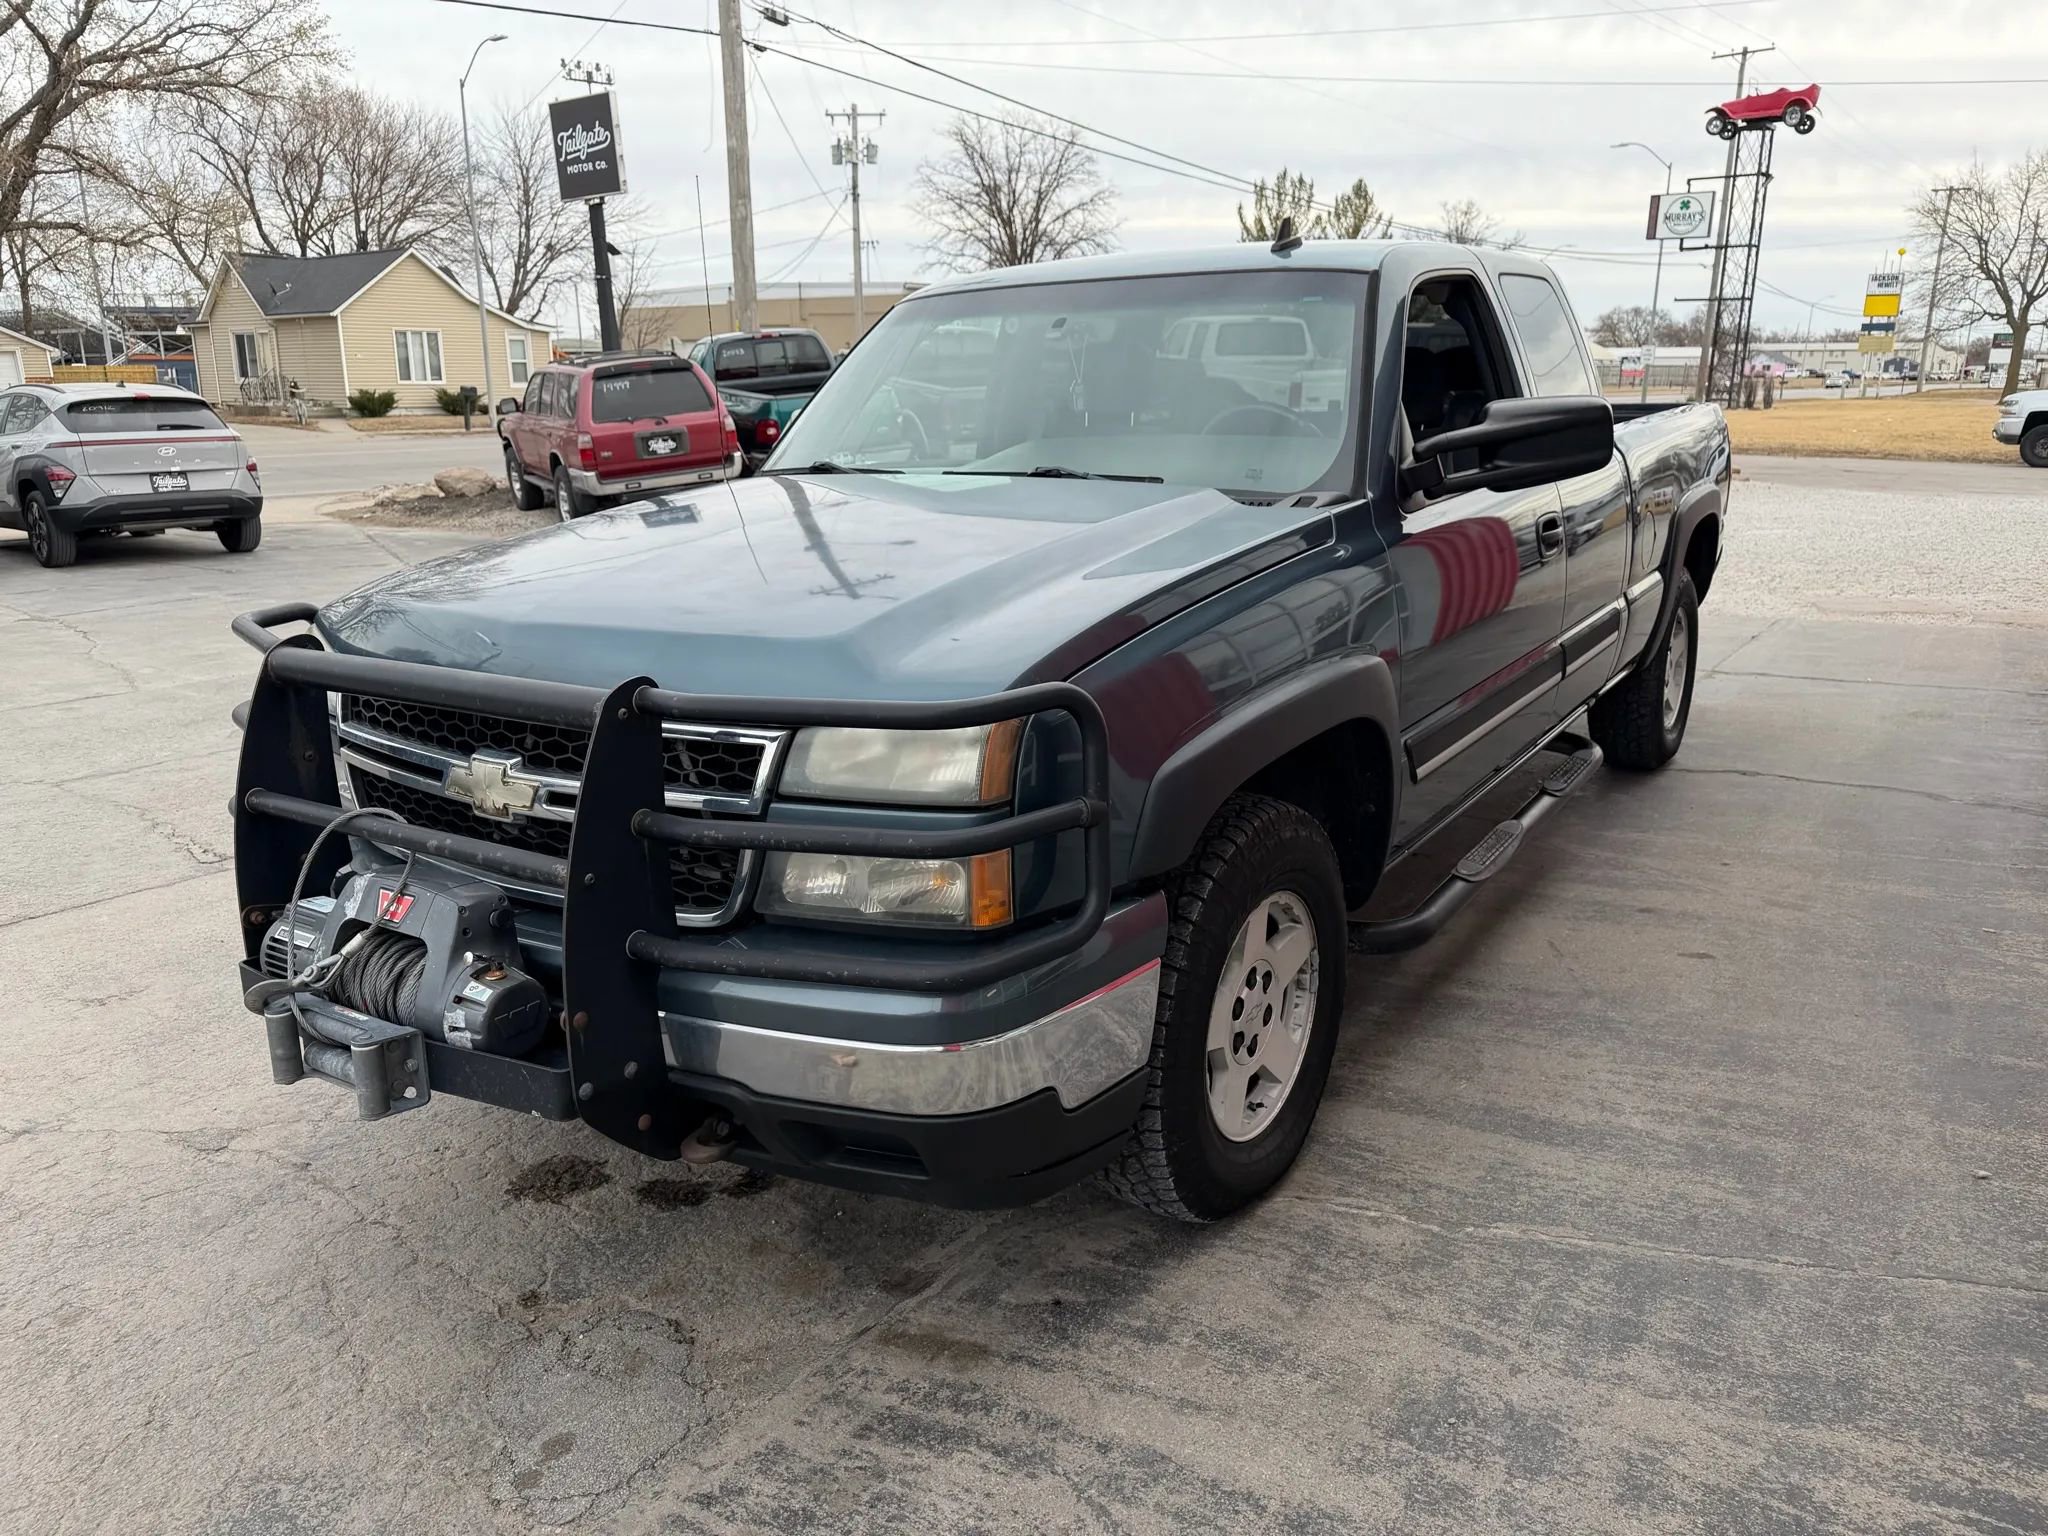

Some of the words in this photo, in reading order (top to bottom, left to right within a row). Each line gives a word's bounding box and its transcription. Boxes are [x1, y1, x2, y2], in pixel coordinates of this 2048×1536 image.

[557, 120, 611, 162] Tailgate
[566, 162, 594, 175] MOTOR
[595, 160, 609, 170] CO.
[1664, 211, 1705, 223] MURRAY'S
[1871, 274, 1900, 282] JACKSON
